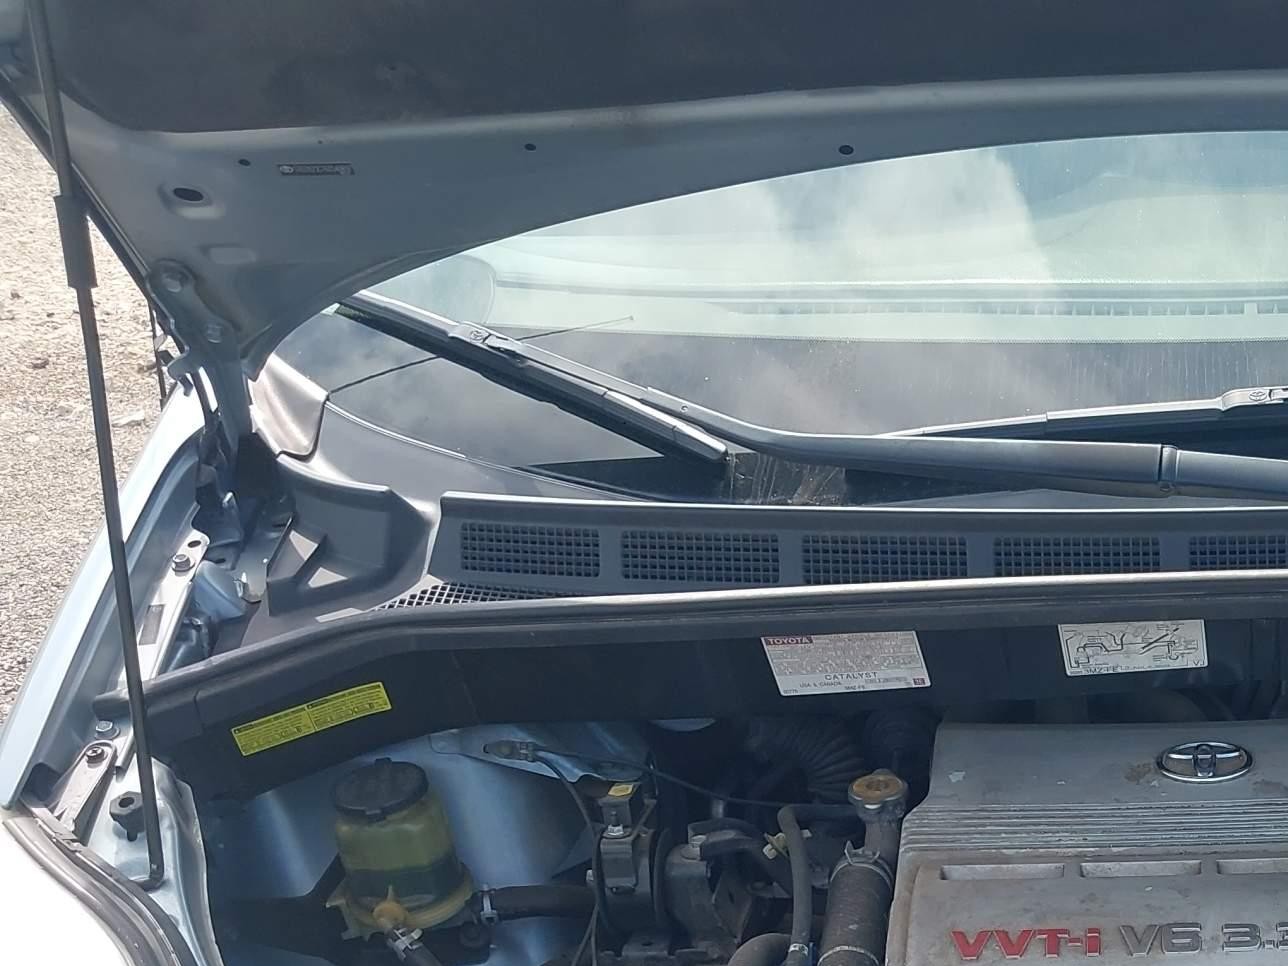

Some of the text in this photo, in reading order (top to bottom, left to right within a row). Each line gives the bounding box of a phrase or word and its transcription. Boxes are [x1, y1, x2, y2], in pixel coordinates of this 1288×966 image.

[767, 636, 811, 646] TOYOTA
[824, 671, 878, 681] CATALYST
[951, 928, 1102, 960] VVT-i
[1120, 922, 1201, 957] V6
